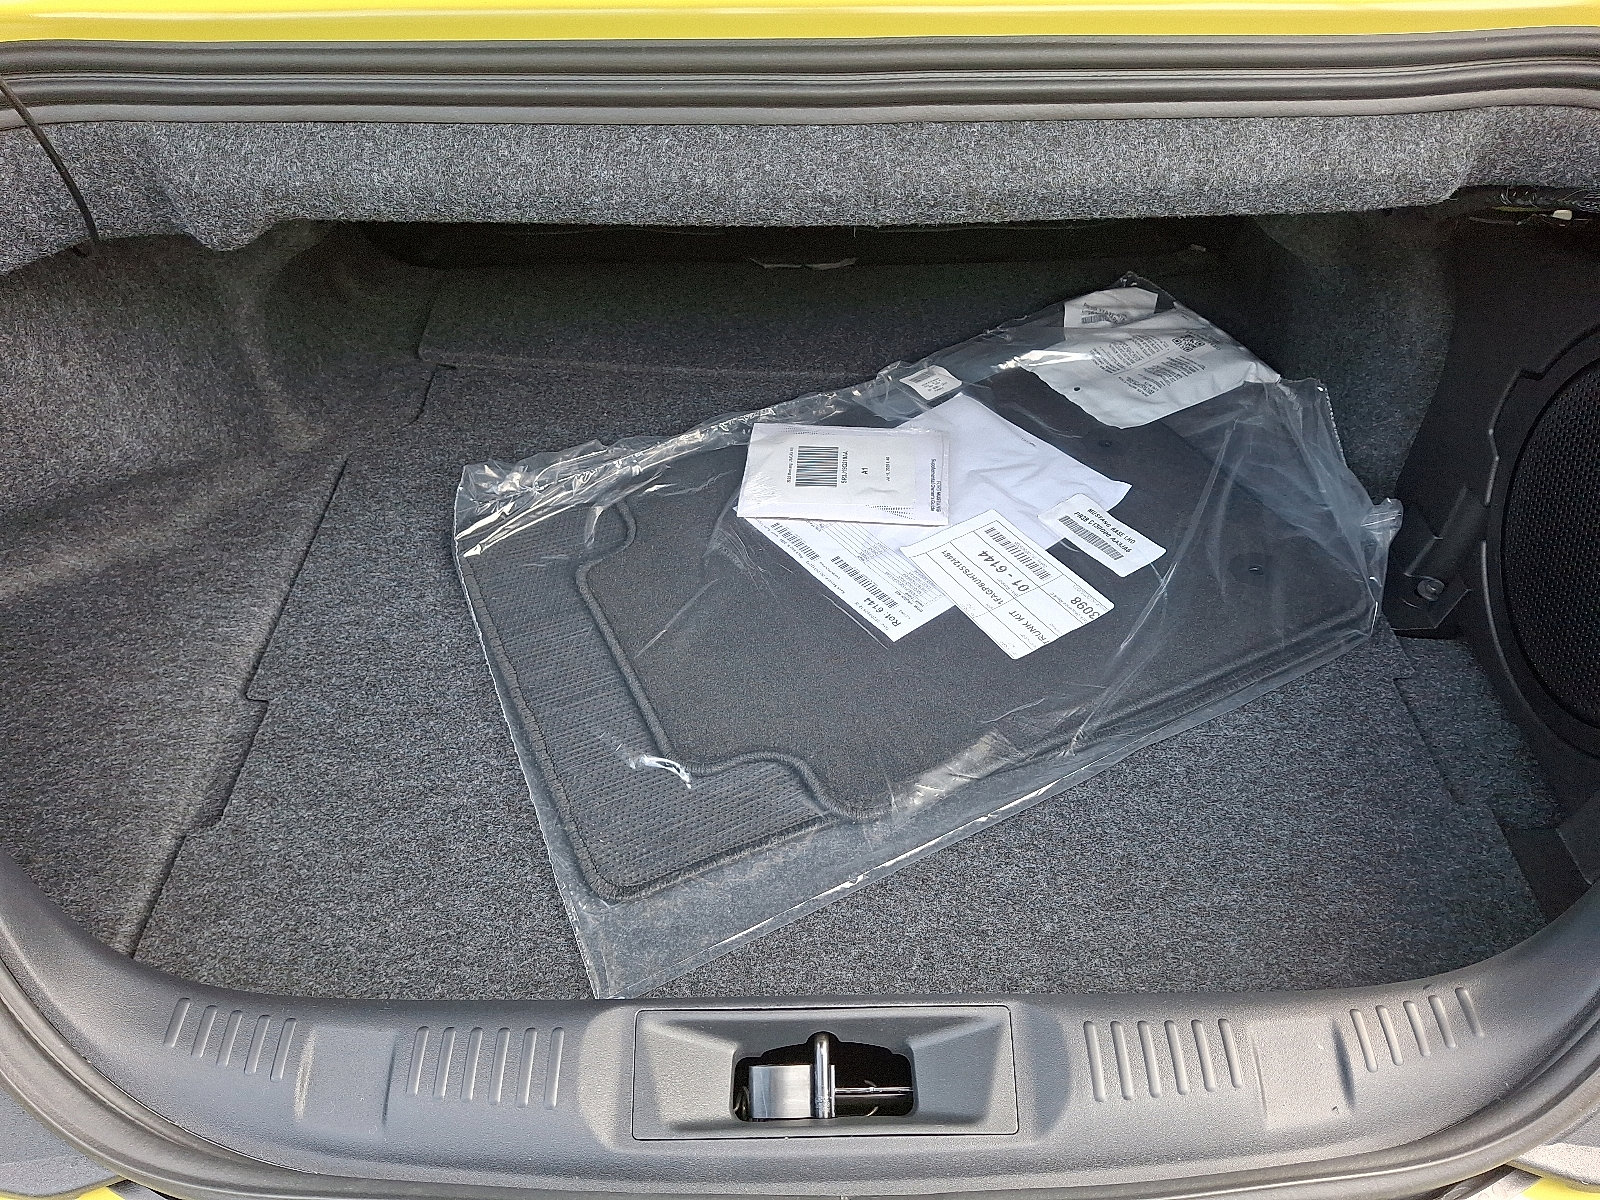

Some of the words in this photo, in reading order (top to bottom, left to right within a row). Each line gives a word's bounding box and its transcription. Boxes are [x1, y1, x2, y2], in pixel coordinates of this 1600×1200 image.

[861, 467, 869, 475] A1
[1087, 508, 1112, 528] MUSTANG
[1110, 526, 1126, 538] BASE
[977, 550, 1008, 573] 6144
[1011, 579, 1030, 592] 01
[863, 597, 884, 613] 6144
[1070, 596, 1101, 620] 3098
[1008, 610, 1025, 622] KIT
[1021, 620, 1050, 645] TRUNK
